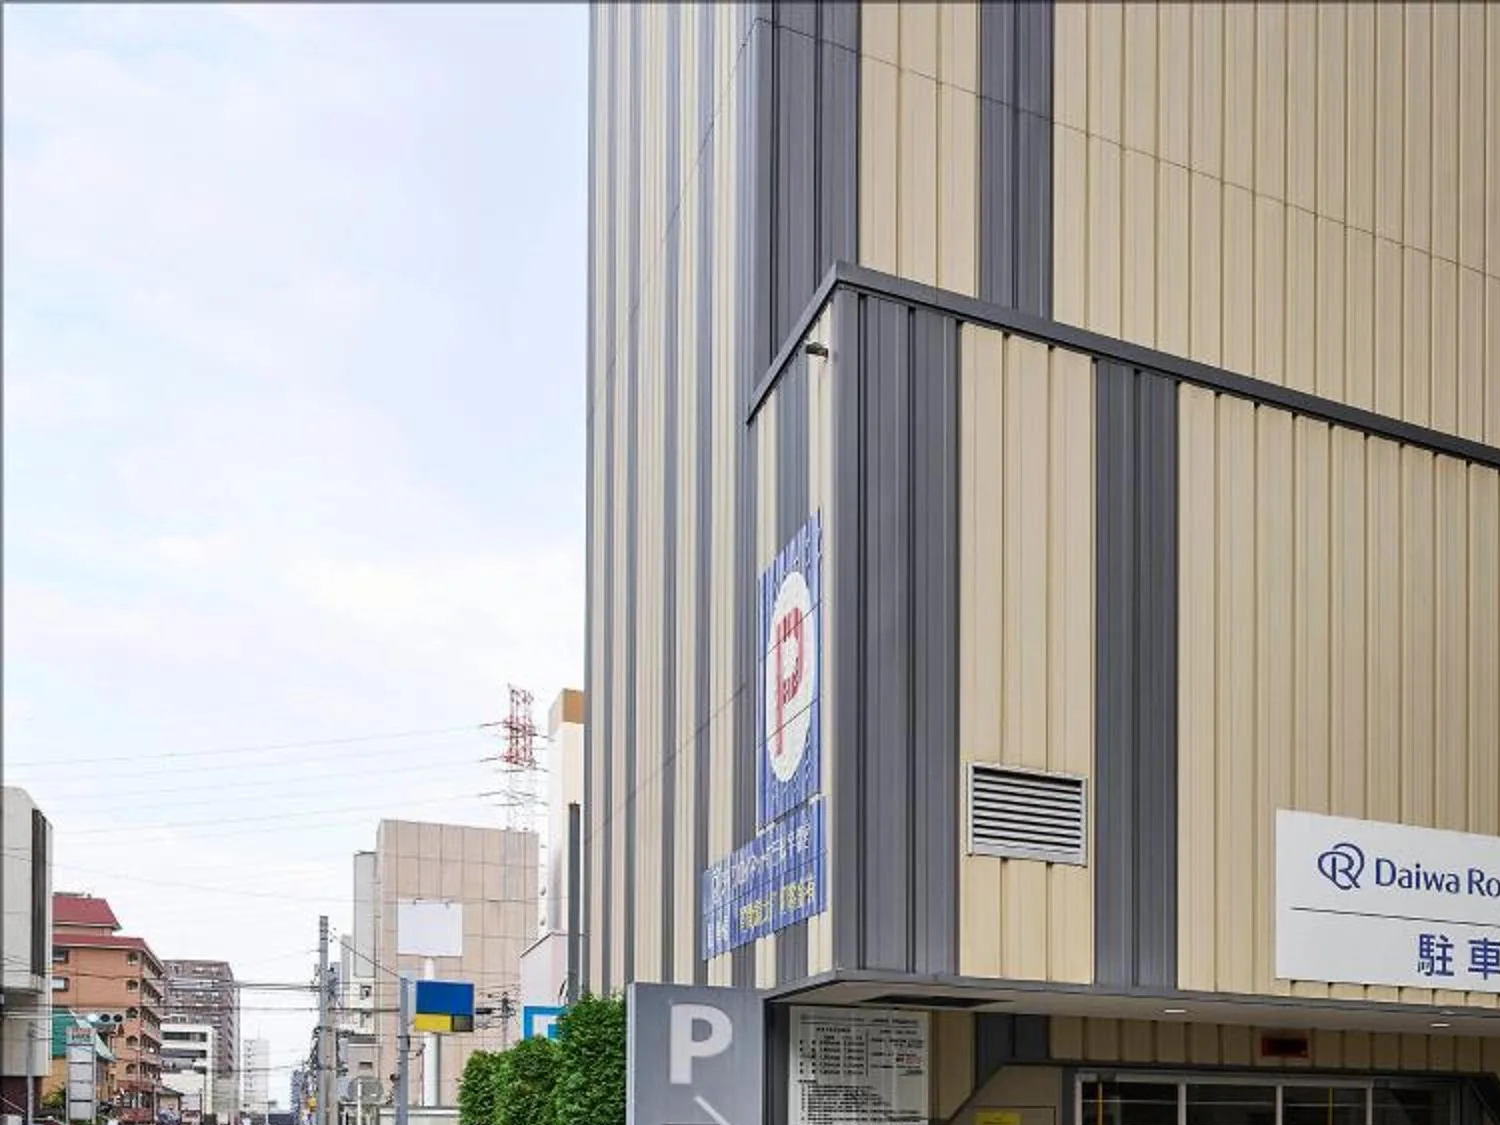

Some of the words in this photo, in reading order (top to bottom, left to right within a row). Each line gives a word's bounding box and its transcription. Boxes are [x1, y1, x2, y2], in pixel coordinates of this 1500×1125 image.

[776, 607, 802, 756] P
[1375, 858, 1460, 894] Daiwa
[669, 1003, 733, 1085] P
